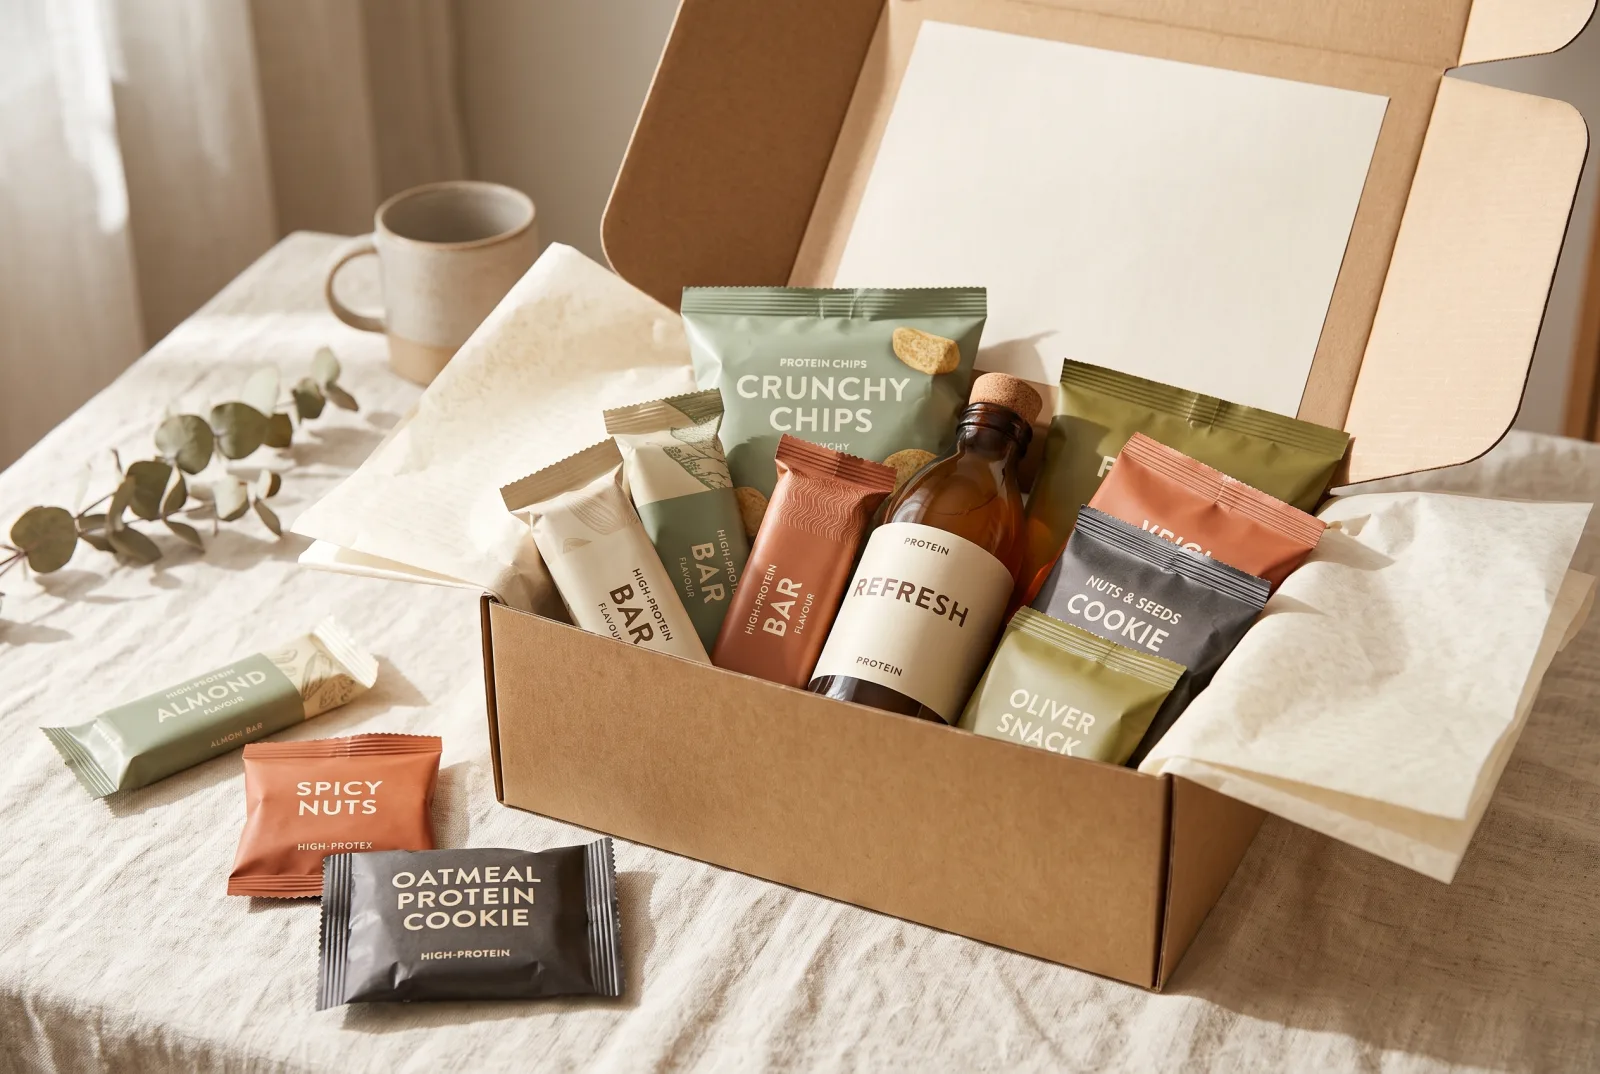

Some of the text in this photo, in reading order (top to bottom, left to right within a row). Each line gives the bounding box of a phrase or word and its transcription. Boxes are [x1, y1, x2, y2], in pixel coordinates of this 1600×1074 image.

[779, 358, 868, 369] PROTEIN CHIPS
[736, 374, 910, 402] CRUNCHY
[769, 406, 873, 433] CHIPS
[904, 537, 950, 556] PROTEIN
[680, 556, 695, 598] FLAVOUR
[691, 542, 725, 604] BAR
[609, 583, 654, 645] BAR
[632, 568, 673, 642] HIGH-PROTEIN
[744, 564, 777, 635] HIGH-PROTEIN
[762, 577, 803, 637] BAR
[794, 593, 815, 635] FLAVOUR
[853, 577, 969, 628] REFRESH
[1085, 575, 1182, 625] NUTS & SEEDS
[1067, 593, 1170, 652] COOKIE
[856, 656, 903, 677] PROTEIN
[157, 670, 266, 724] ALMOND
[166, 668, 236, 699] HIGH-PROTEIN
[203, 696, 245, 715] FLAVOUR
[1009, 688, 1095, 735] OLIVER
[246, 722, 263, 734] BAR
[996, 713, 1081, 756] SNACK
[296, 780, 383, 796] SPICY
[298, 799, 377, 816] NUTS
[297, 841, 373, 851] HIGH-PROTEX
[392, 866, 541, 889] OATMEAL
[397, 887, 534, 910] PROTEIN
[403, 909, 529, 931] COOKIE
[420, 949, 511, 961] HIGH-PROTEIN
